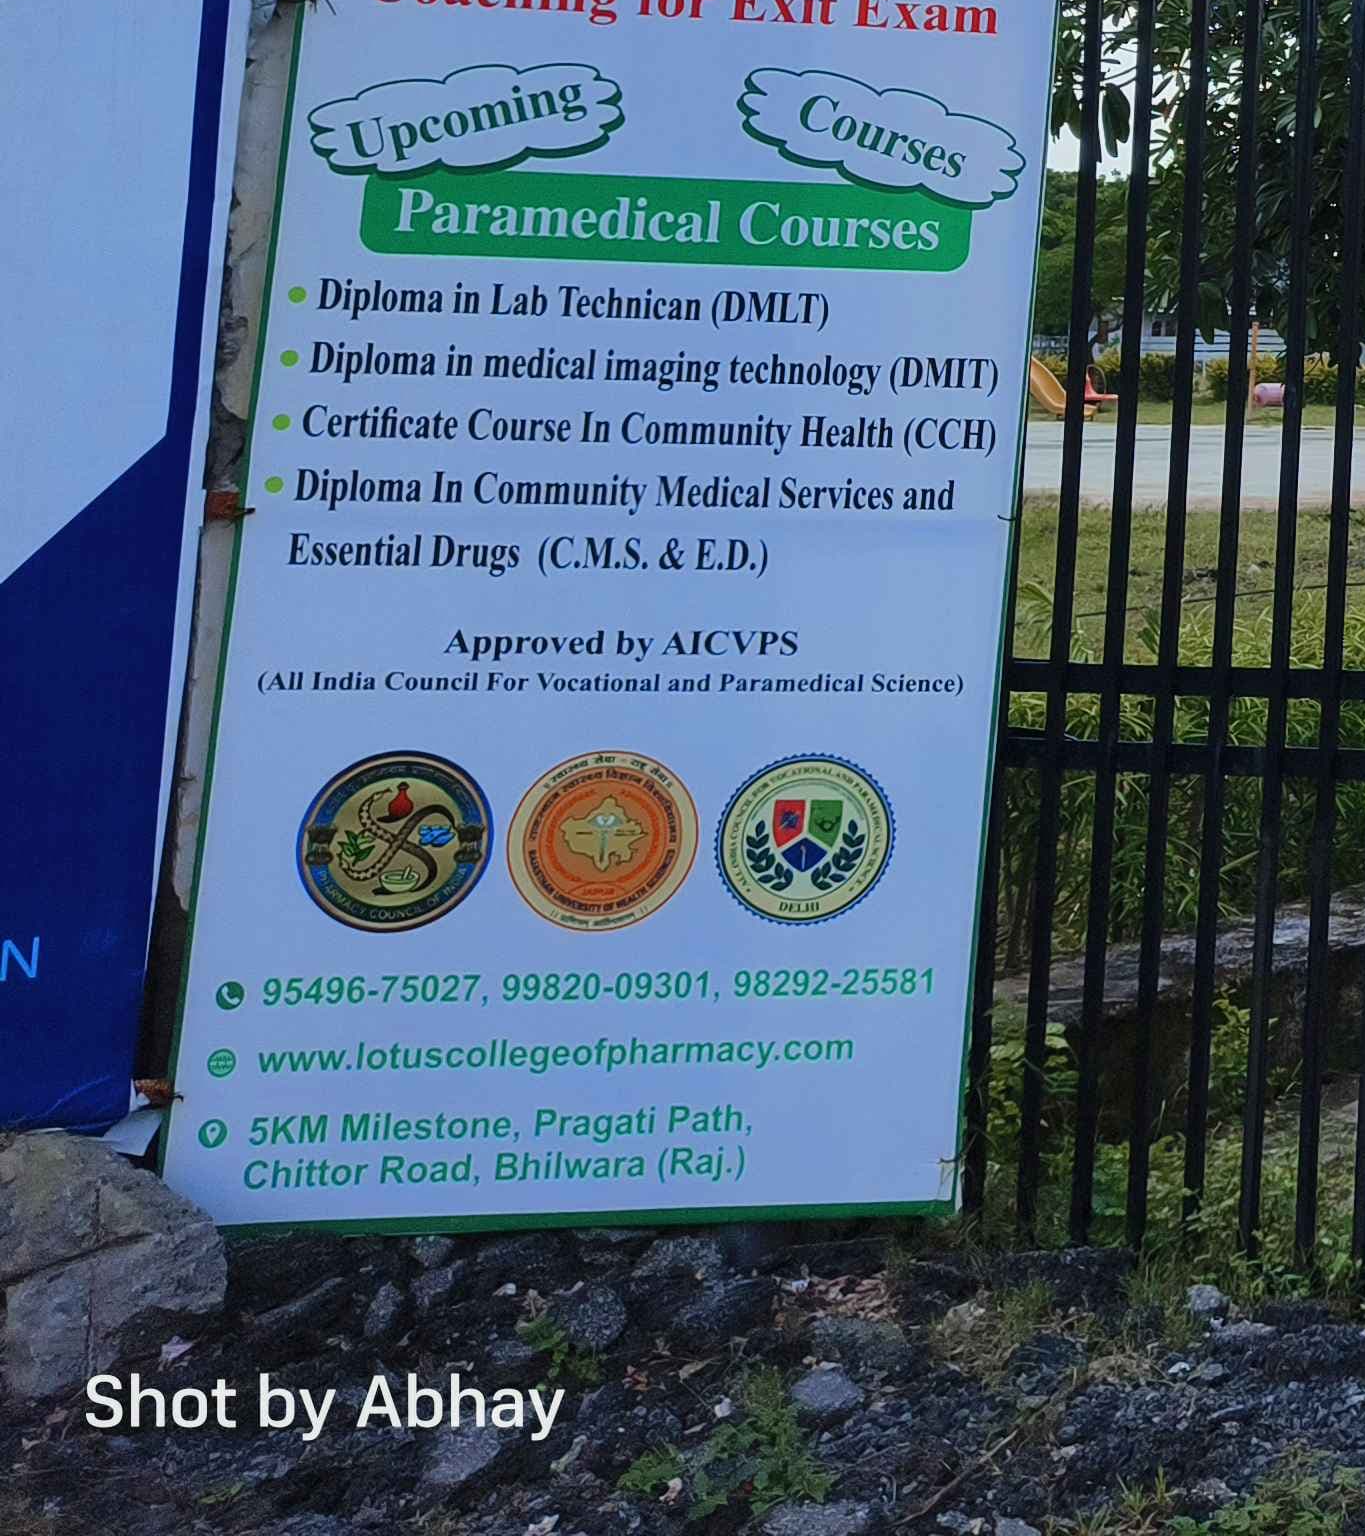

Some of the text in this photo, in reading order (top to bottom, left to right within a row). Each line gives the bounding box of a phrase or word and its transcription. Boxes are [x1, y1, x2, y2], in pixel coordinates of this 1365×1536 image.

[345, 80, 588, 166] Upcoming
[798, 92, 968, 182] Courses
[393, 187, 942, 254] Paramedical Courses
[316, 279, 831, 331] Diploma in Lab Technican (DMLT)
[308, 342, 1000, 397] Diploma in medical imaging technology (DMIT)
[301, 405, 997, 457] Certificate Course In Community Health (CCH)
[294, 469, 955, 516] Diploma In Community Medical Services and
[287, 533, 769, 577] Essential Drugs (C.M.S. & E.D.)
[443, 628, 800, 662] Approved by AICVPS
[256, 670, 966, 697] (All India Council For Vocational and Paramedical Science)
[261, 967, 936, 1010] 95496-75027, 99820-09301, 98292-25581
[257, 1033, 854, 1074] www.lotuscollegeofpharmacy.com
[248, 1103, 754, 1146] 5KM Milestone, Pragati Path,
[242, 1144, 747, 1190] Chittor Road, Bhilwara (Raj.)
